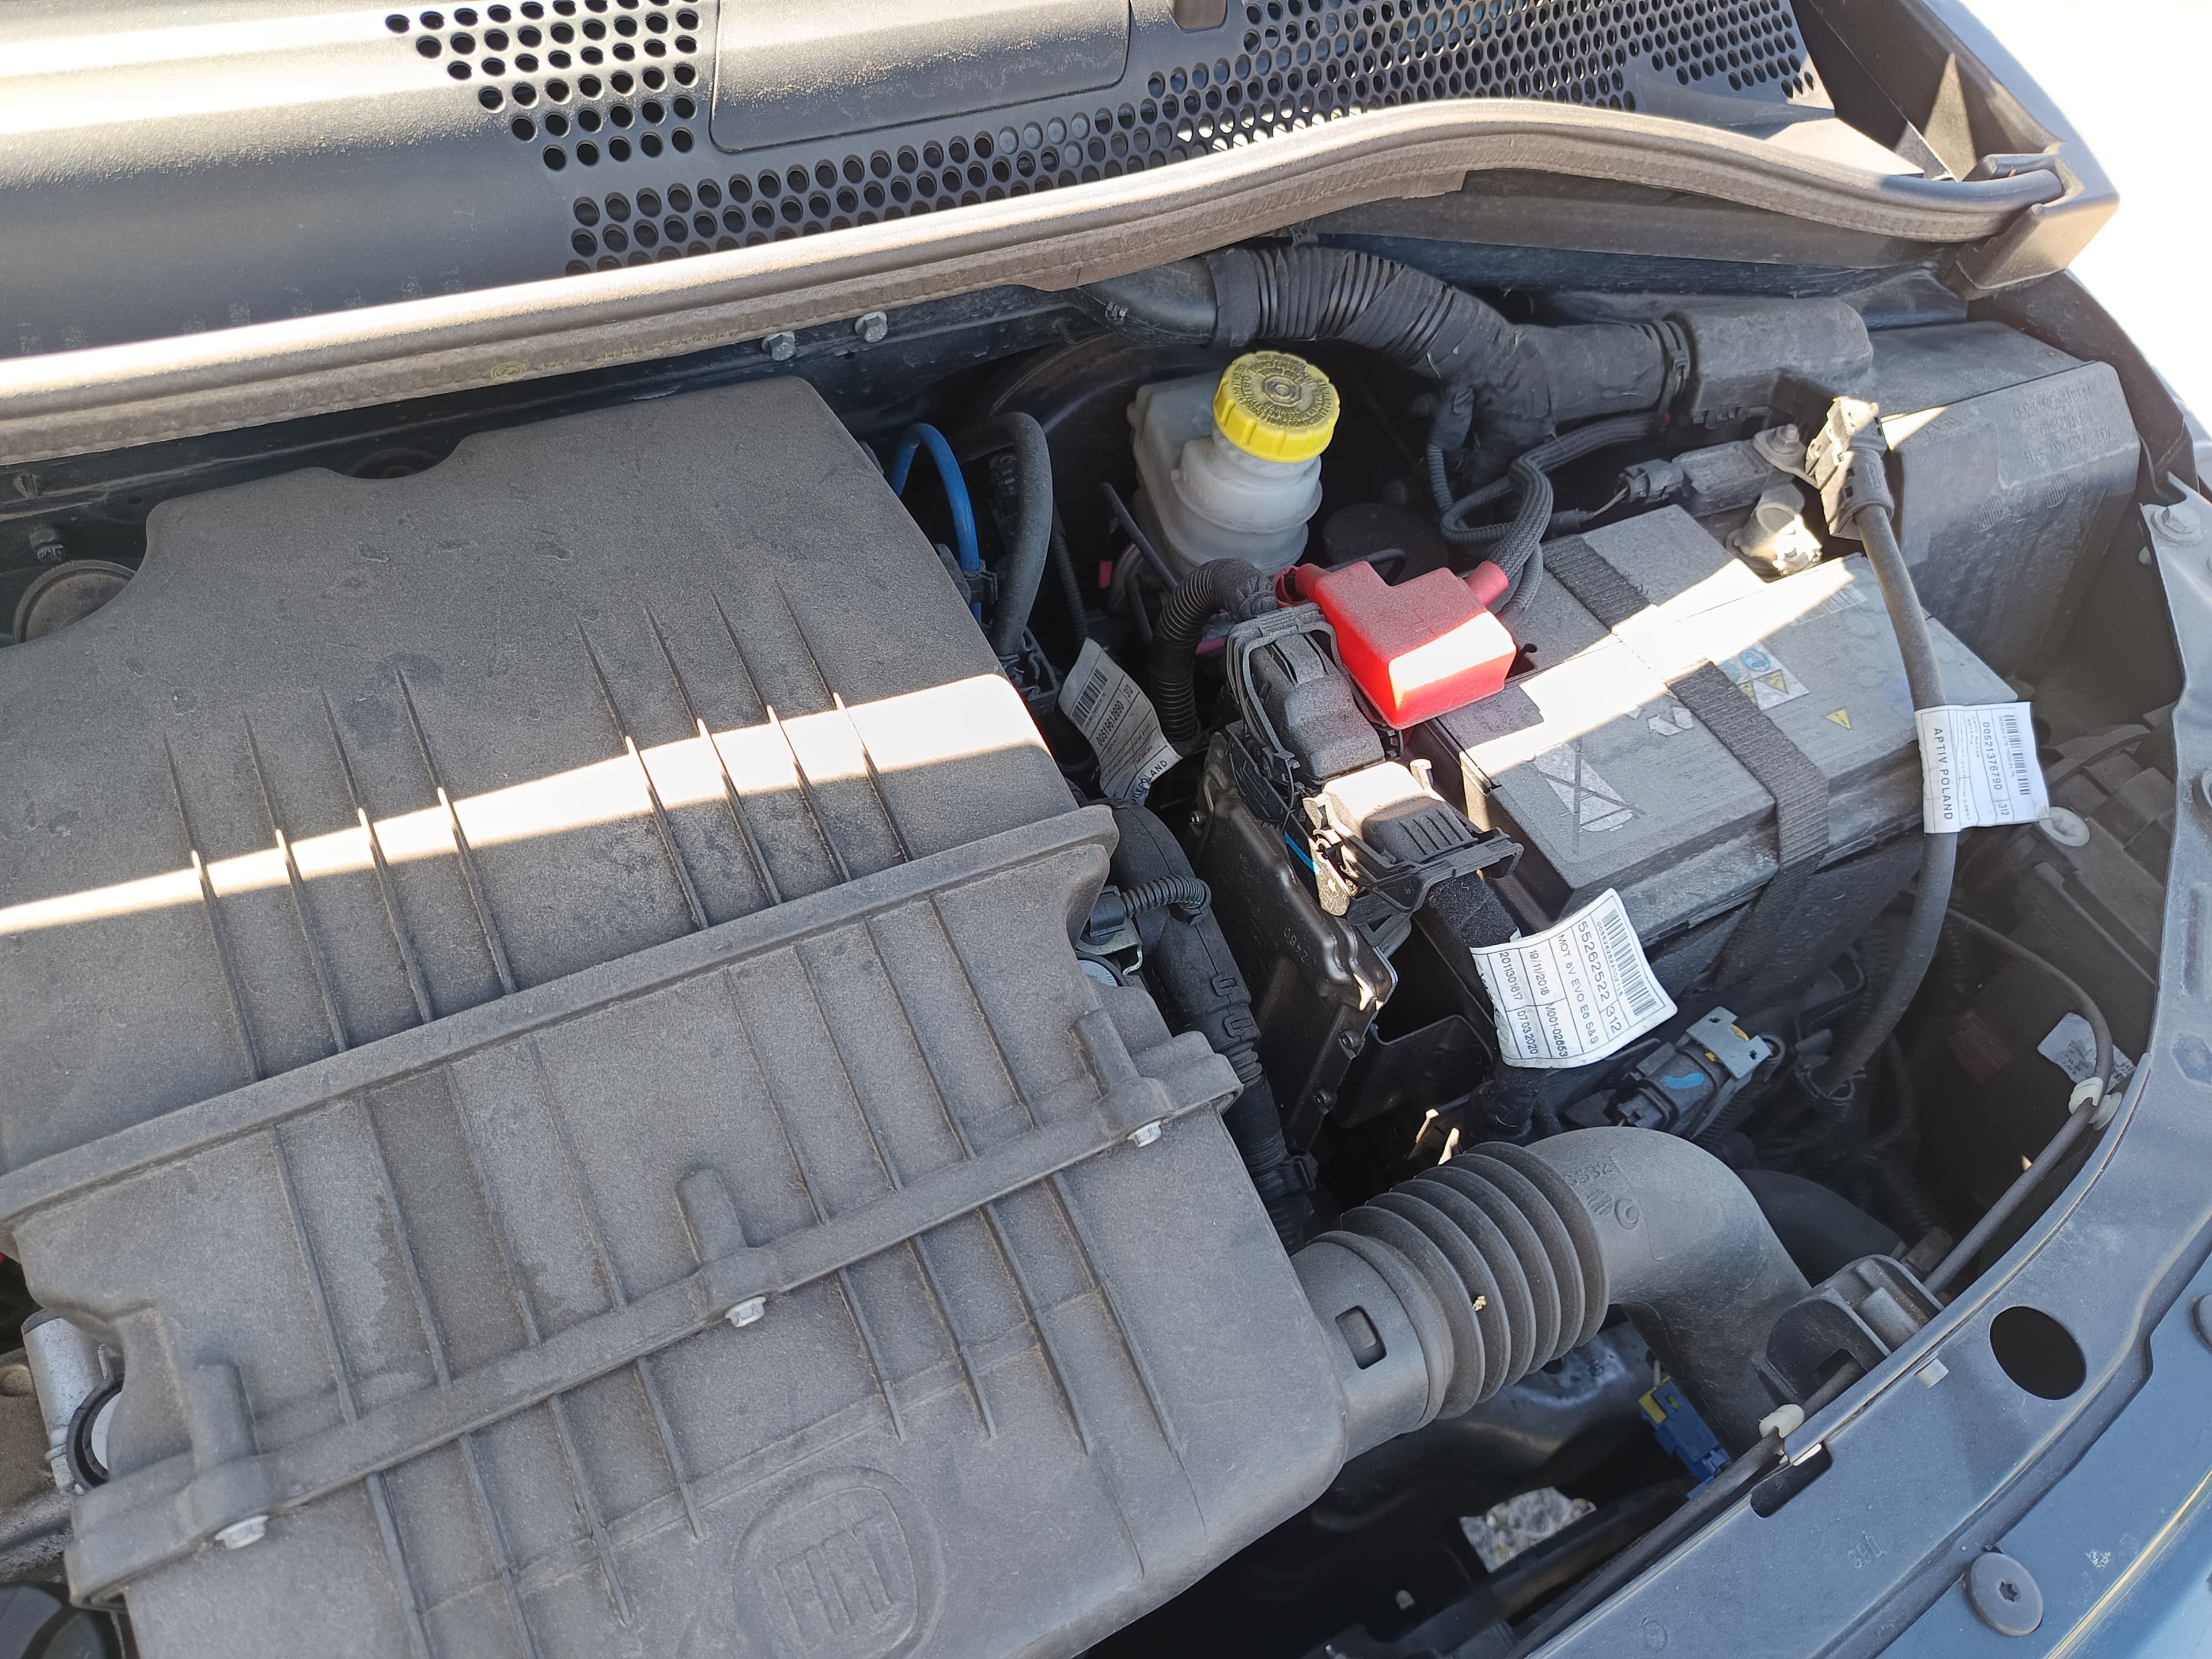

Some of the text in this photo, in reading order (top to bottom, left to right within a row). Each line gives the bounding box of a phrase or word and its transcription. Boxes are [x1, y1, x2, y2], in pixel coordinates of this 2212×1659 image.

[1096, 700, 1124, 747] 00519612890
[1123, 684, 1133, 699] 312
[1933, 728, 1953, 820] APTIV POLAND
[1983, 722, 2009, 816] 00521376790 312
[1557, 934, 1571, 957] MOT
[1571, 979, 1585, 1003] EVO
[1585, 1022, 1599, 1044] S&S
[1578, 921, 1622, 1033] 55262522 312
[1516, 1010, 1539, 1055] 07.03.2020
